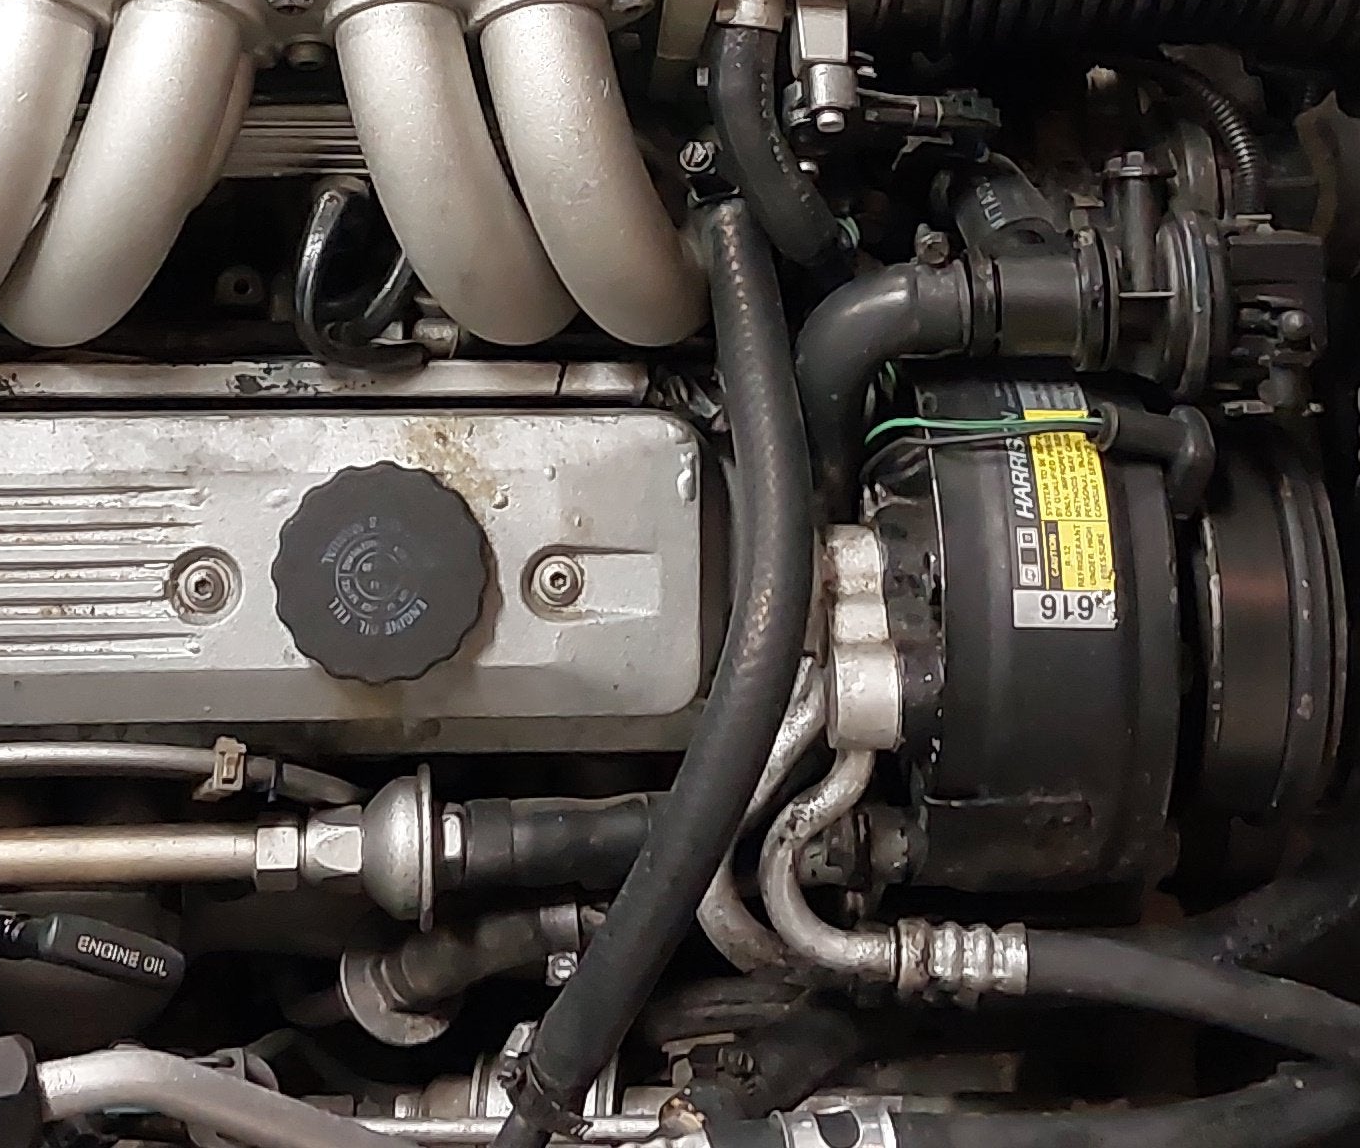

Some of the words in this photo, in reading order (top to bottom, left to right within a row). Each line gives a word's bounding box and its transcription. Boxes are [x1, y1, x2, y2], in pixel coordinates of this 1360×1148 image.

[1048, 533, 1060, 577] CAUTION
[77, 935, 141, 969] ENGINE
[143, 956, 168, 978] OIL
